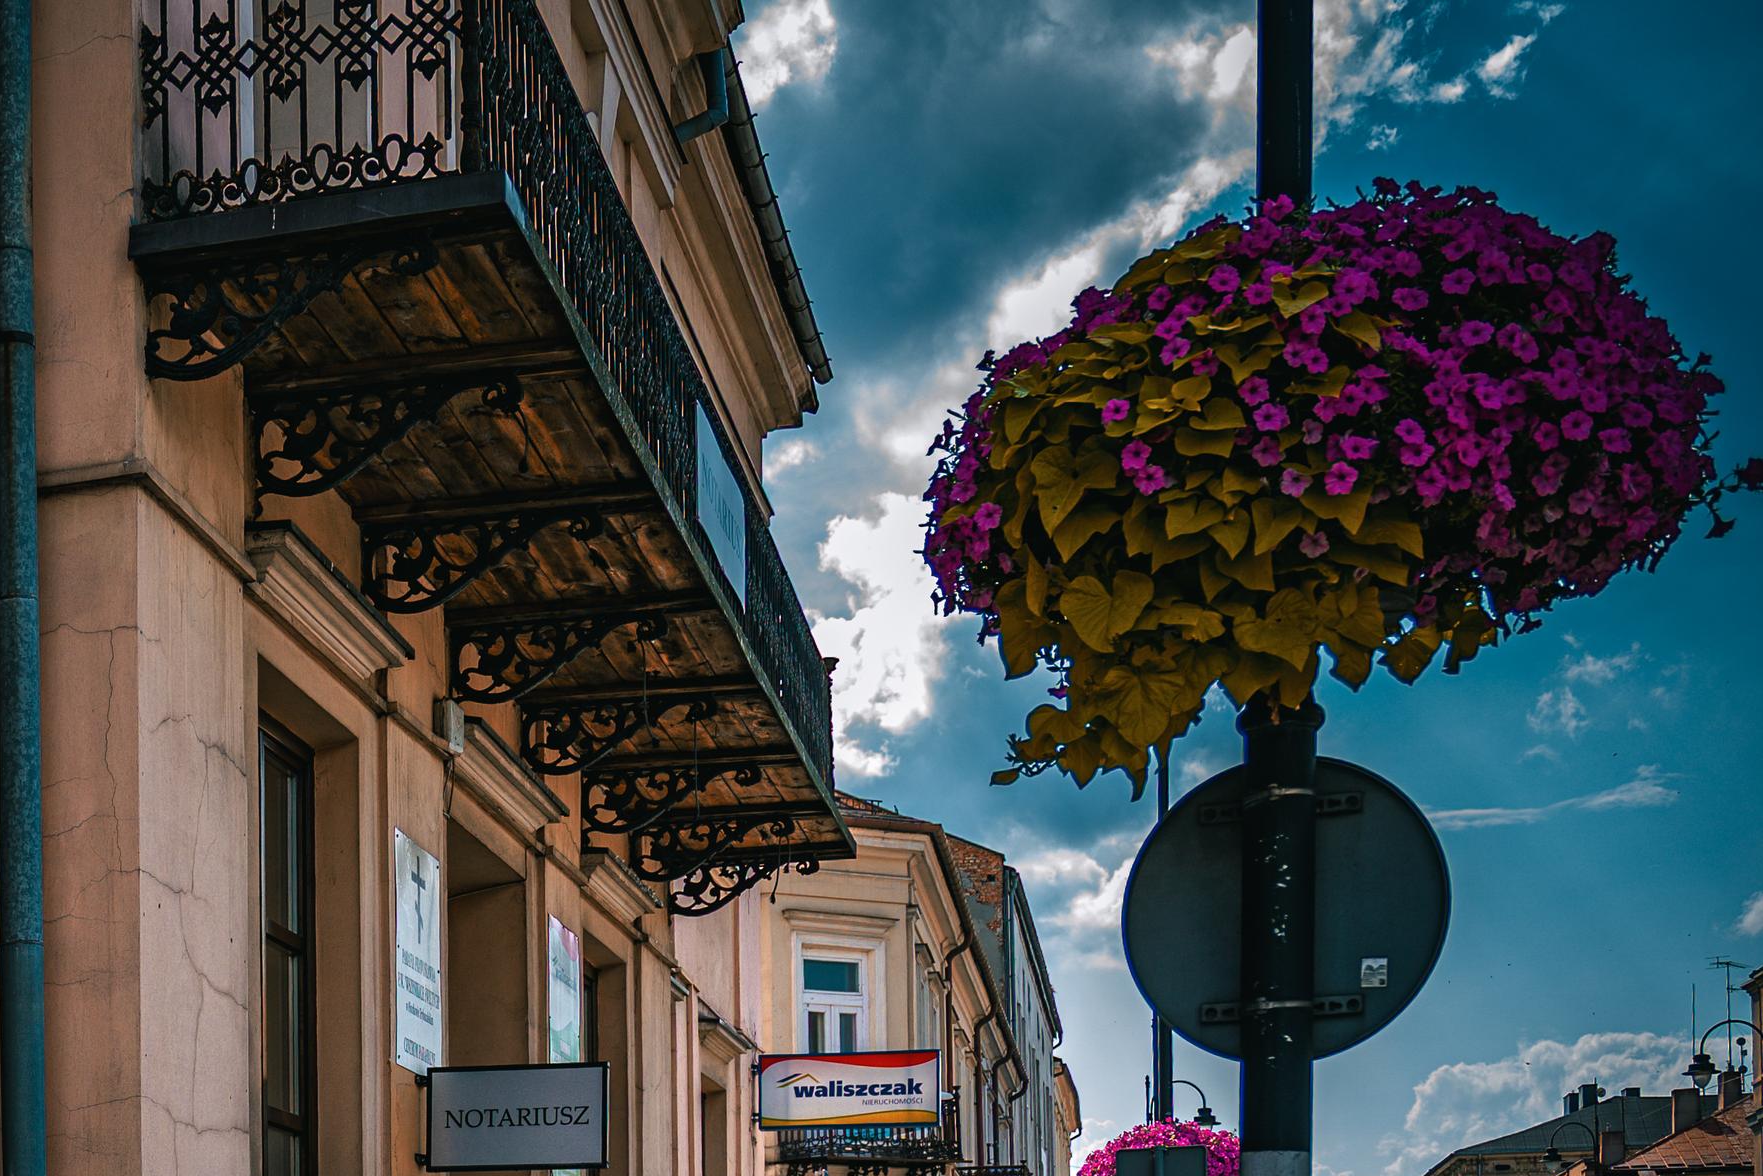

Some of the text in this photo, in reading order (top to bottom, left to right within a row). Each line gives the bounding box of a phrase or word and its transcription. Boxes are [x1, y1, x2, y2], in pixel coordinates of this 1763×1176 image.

[794, 1078, 923, 1098] waliszczak
[862, 1097, 923, 1106] NIERUCHOMOŚCI
[444, 1106, 590, 1129] NOTARIUSZ
